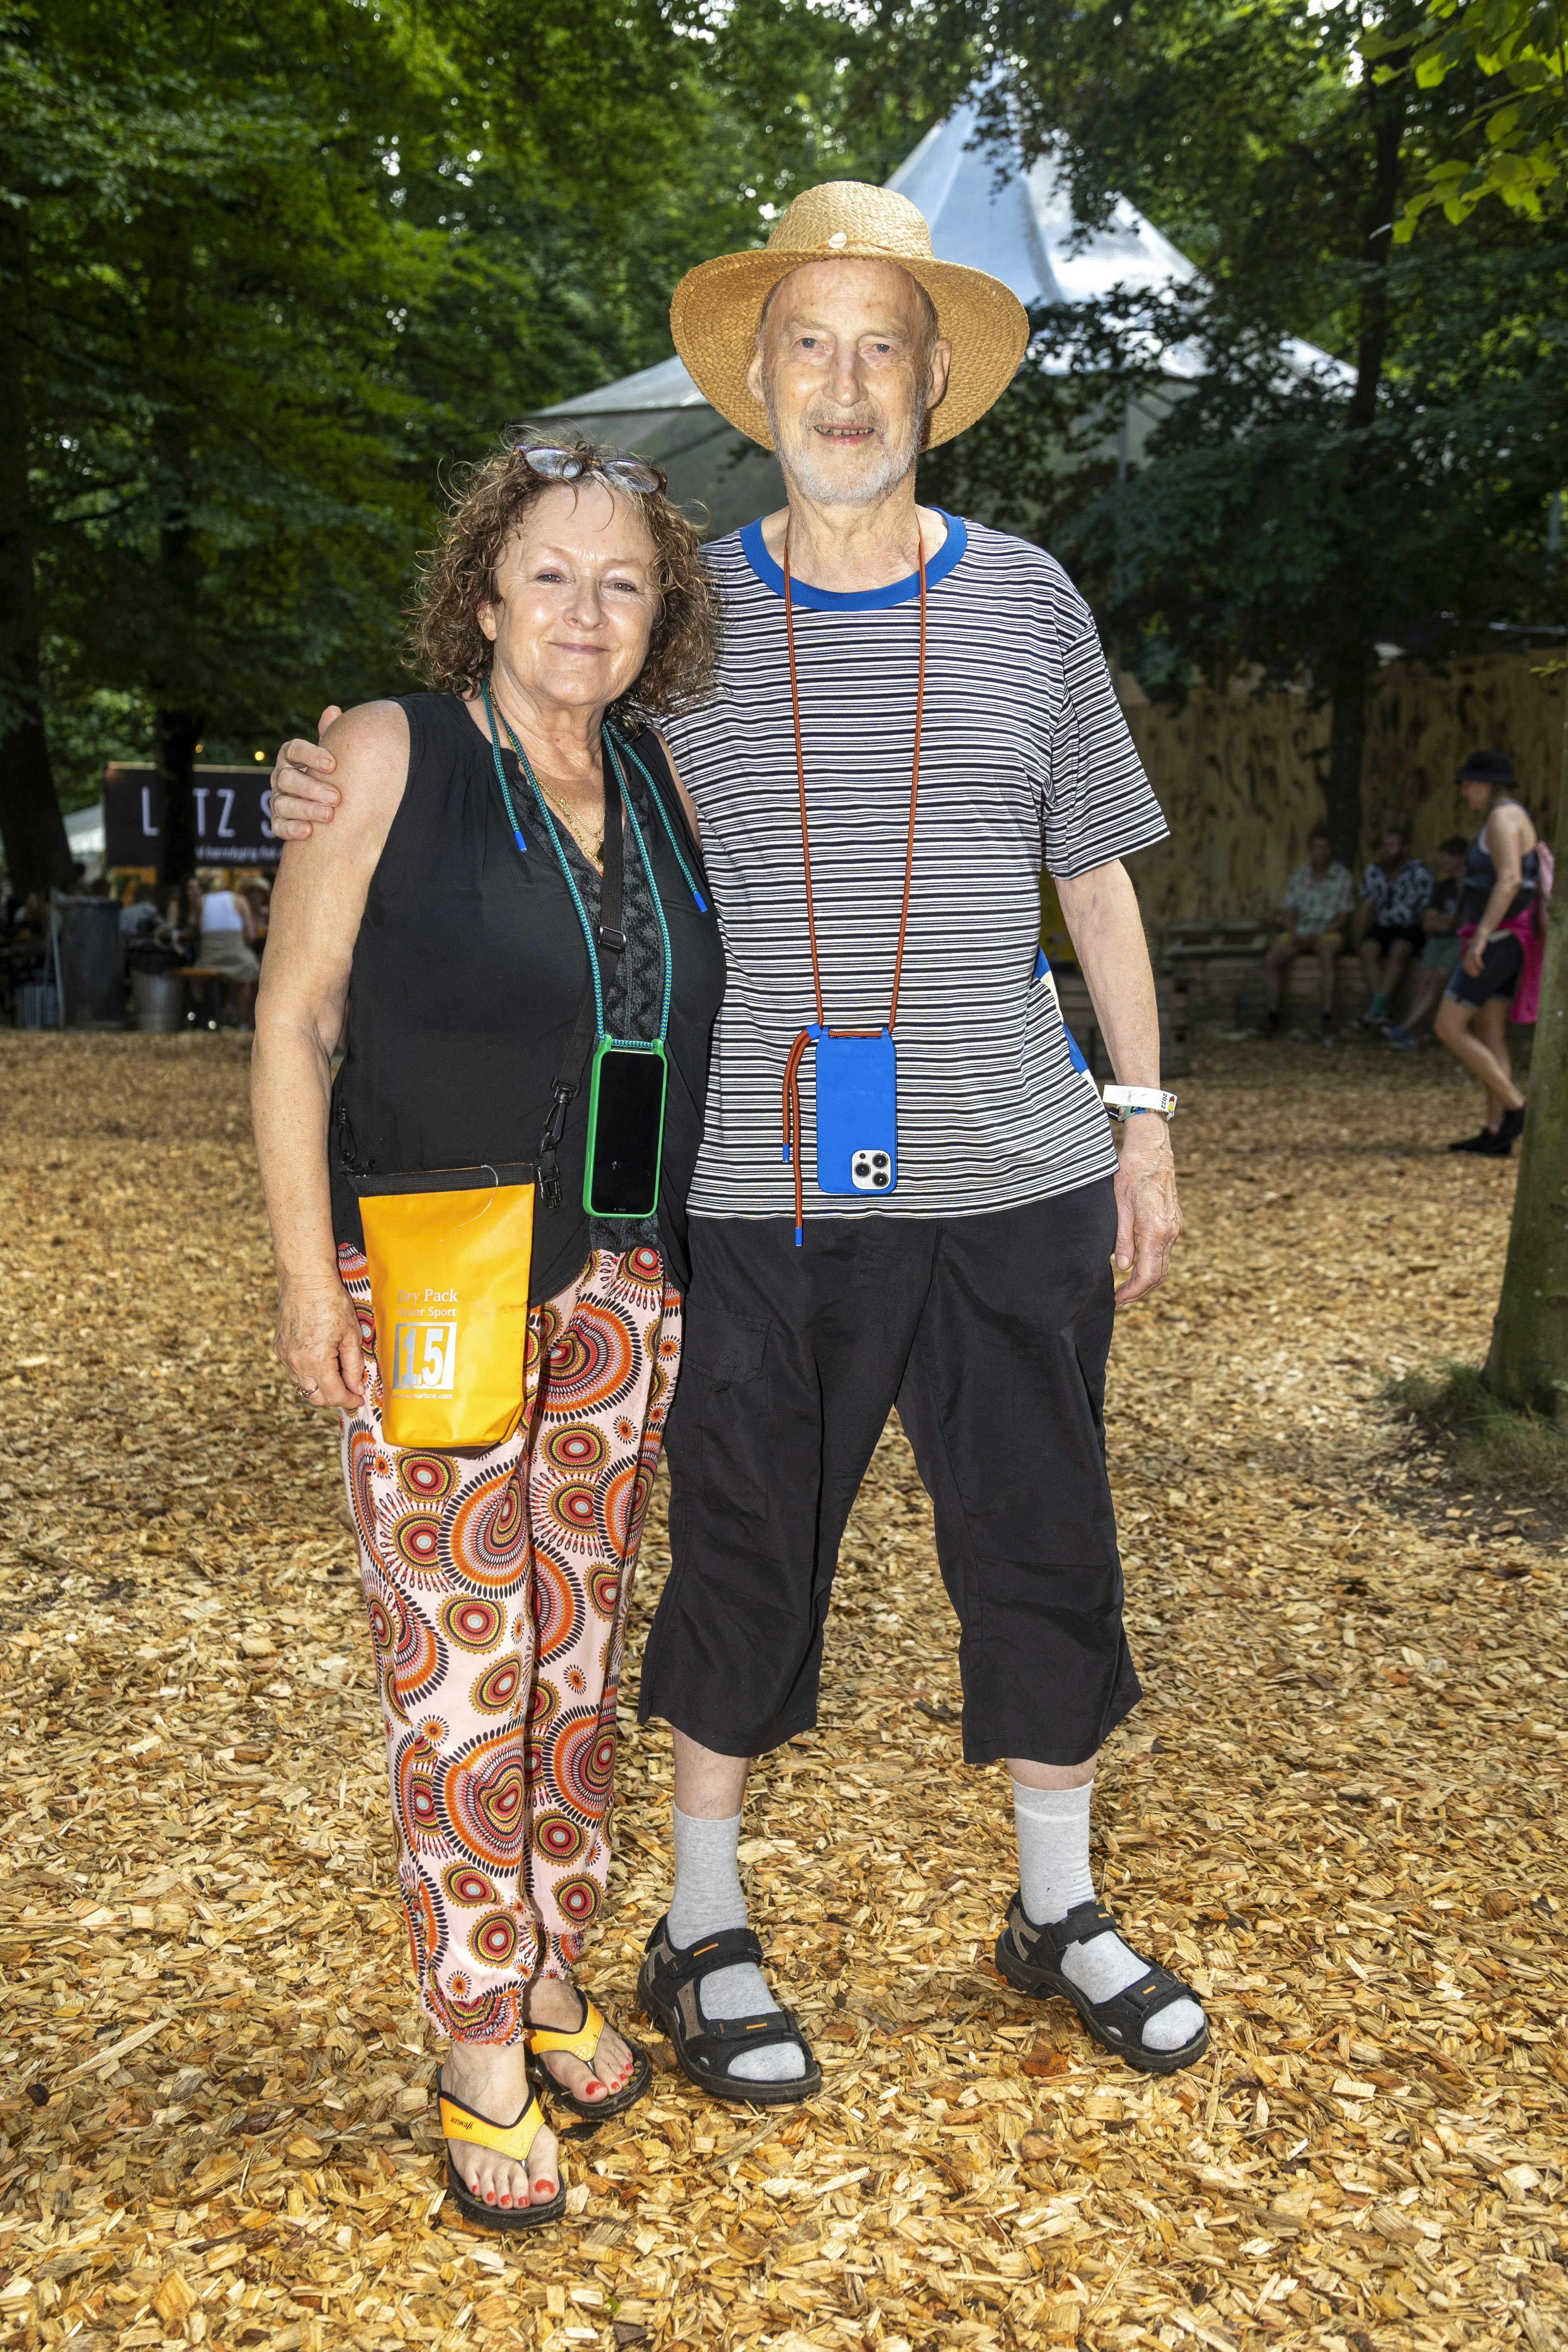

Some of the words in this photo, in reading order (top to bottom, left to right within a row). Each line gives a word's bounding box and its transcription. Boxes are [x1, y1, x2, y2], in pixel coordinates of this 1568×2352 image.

[141, 786, 235, 837] LTZ
[397, 1289, 420, 1306] Dry
[423, 1288, 458, 1302] Pack
[397, 1308, 426, 1317] Water
[428, 1306, 456, 1319] Sport
[401, 1328, 444, 1387] 1.5
